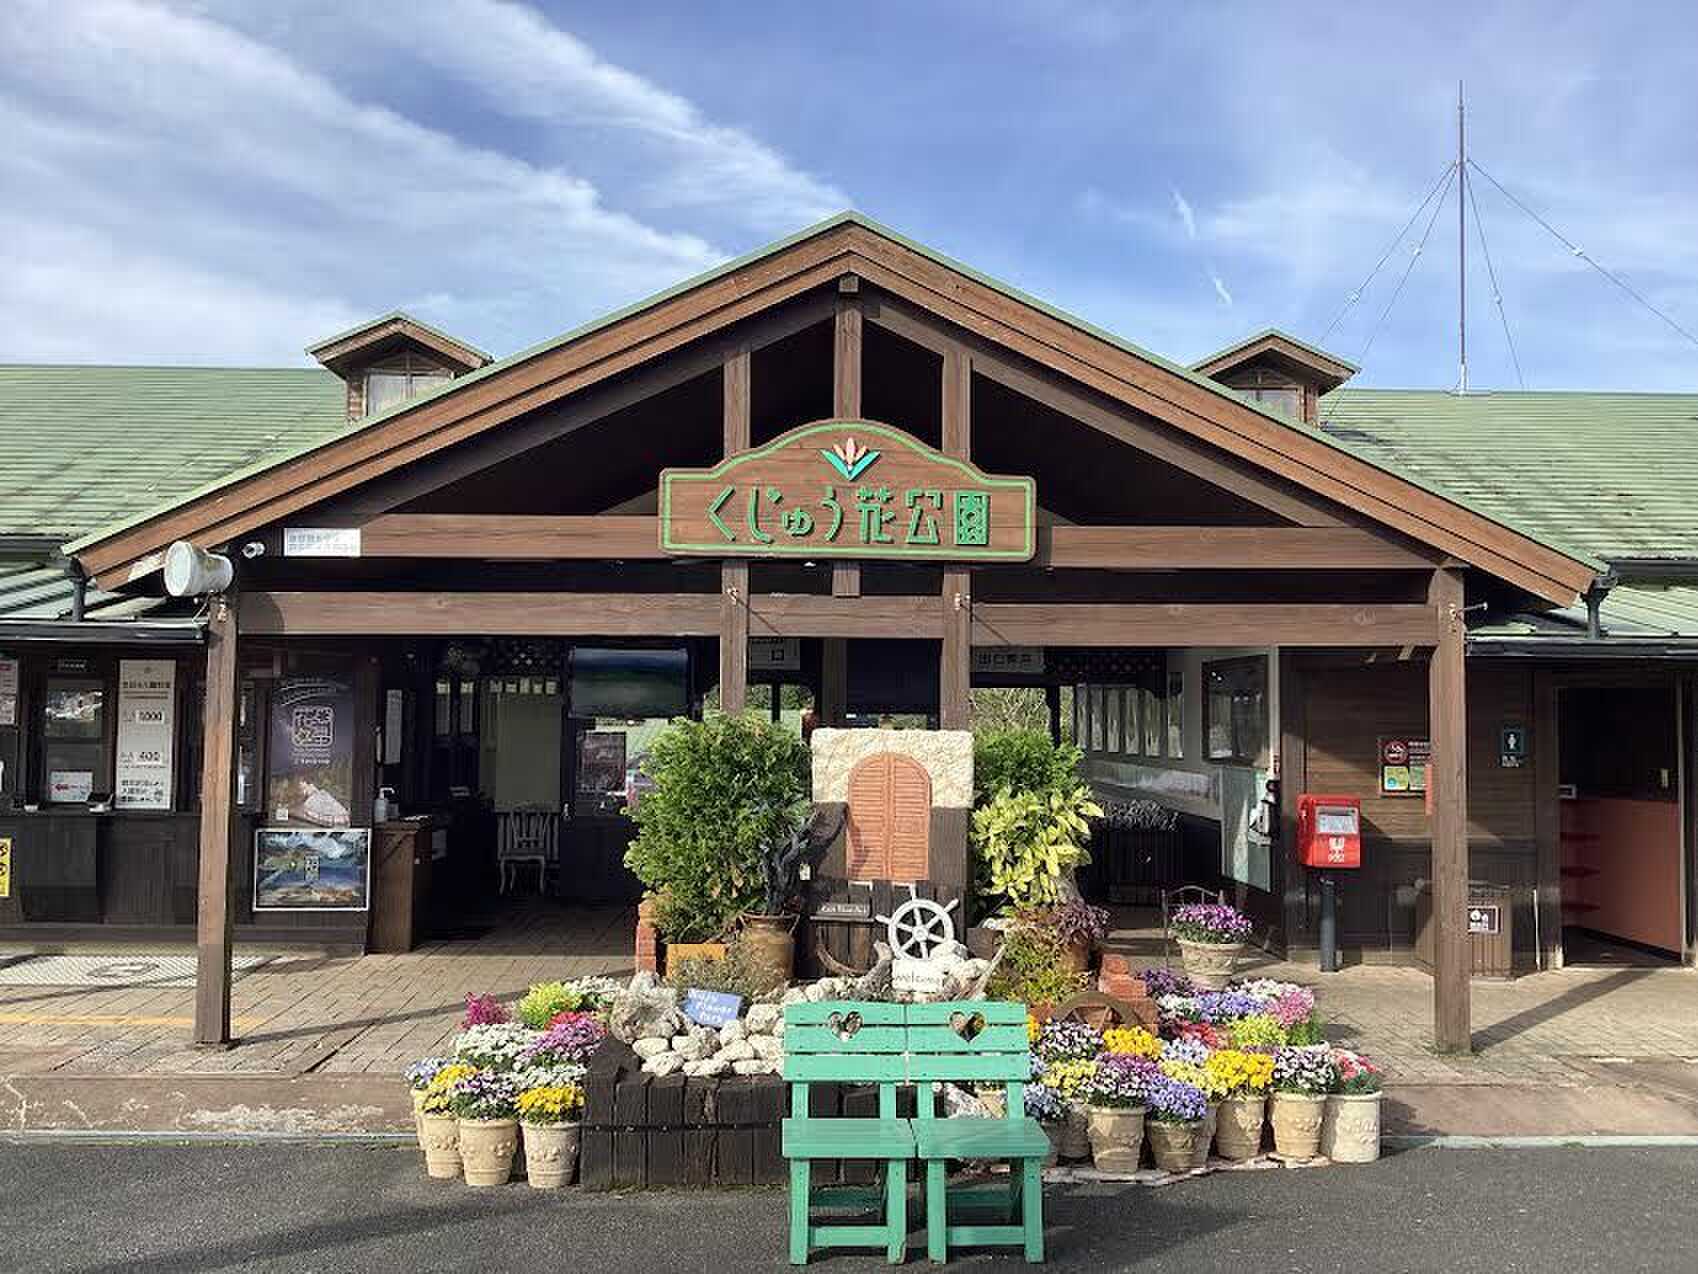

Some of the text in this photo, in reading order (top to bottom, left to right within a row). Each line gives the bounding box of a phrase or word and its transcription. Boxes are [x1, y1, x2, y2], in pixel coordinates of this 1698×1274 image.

[707, 485, 990, 546] くじゅう花公園
